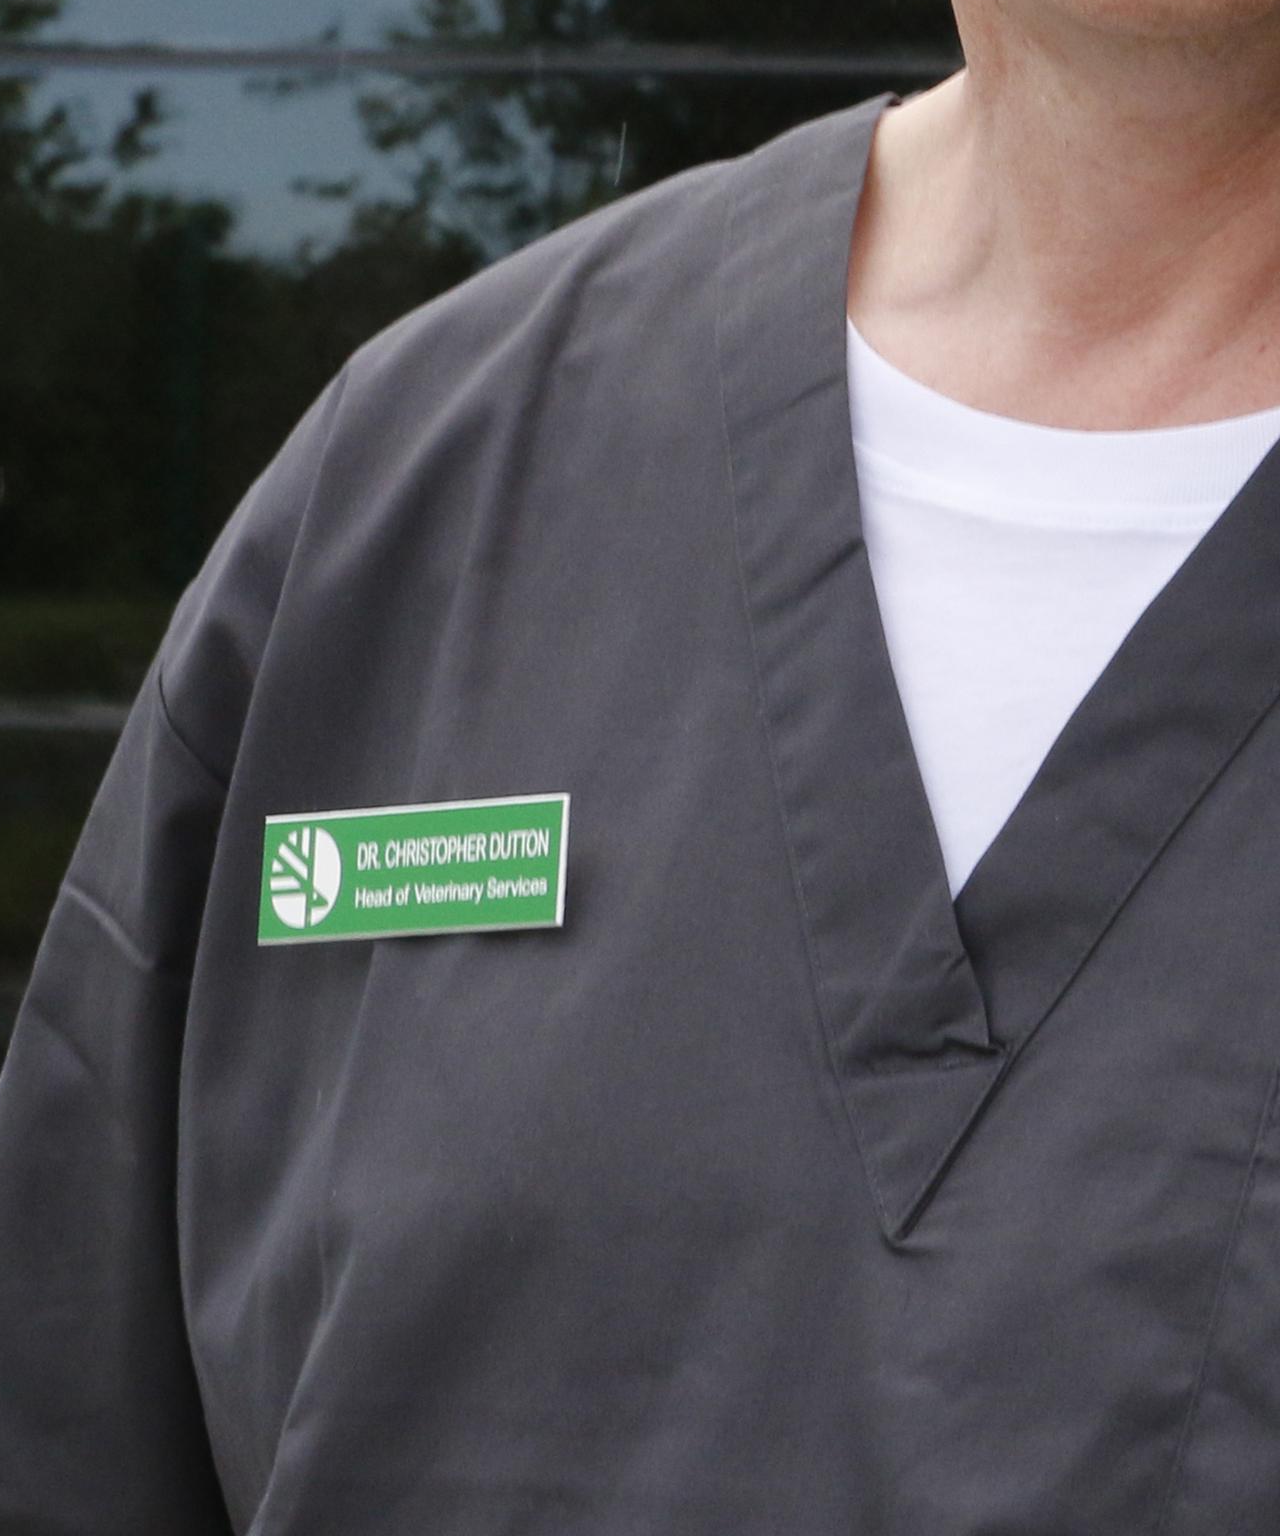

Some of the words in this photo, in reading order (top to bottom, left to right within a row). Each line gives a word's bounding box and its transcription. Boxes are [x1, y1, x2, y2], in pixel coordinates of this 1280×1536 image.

[357, 841, 381, 871] DR.
[384, 831, 487, 868] CHRISTOPHER
[489, 827, 550, 861] DUTTON
[355, 884, 392, 909] Head
[395, 882, 411, 907] of
[414, 880, 484, 905] Veterinary
[487, 875, 548, 899] Services
